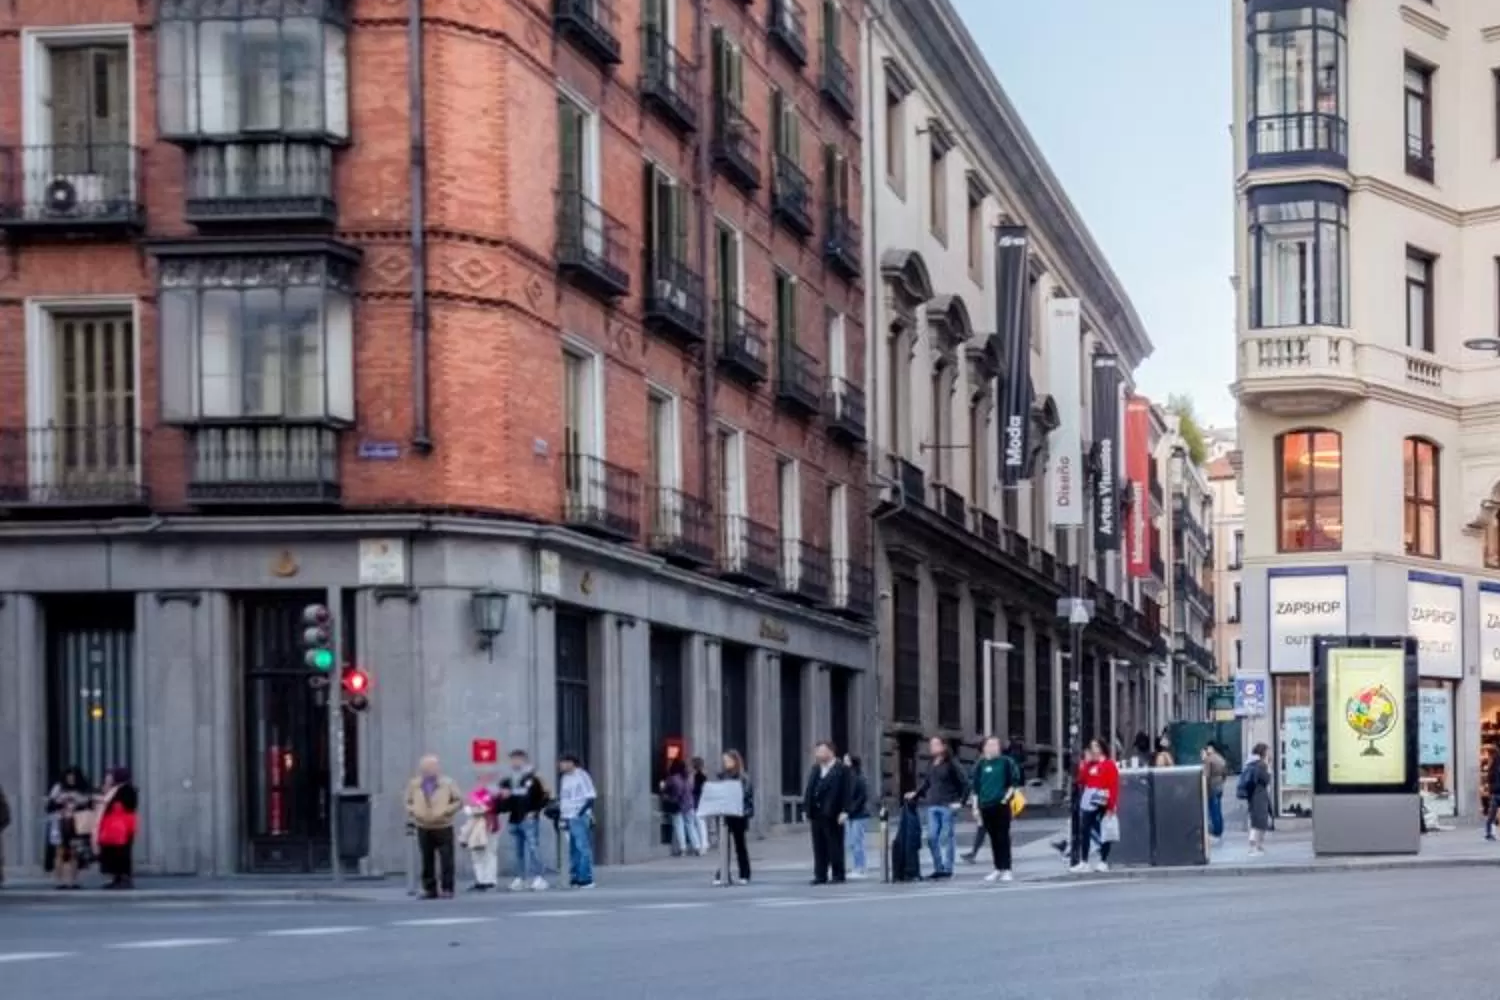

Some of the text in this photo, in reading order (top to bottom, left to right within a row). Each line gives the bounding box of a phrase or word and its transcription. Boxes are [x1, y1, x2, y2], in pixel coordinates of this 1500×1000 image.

[1005, 414, 1023, 467] Moda
[1057, 456, 1071, 507] Diseño
[1098, 497, 1113, 536] Artes
[1275, 600, 1342, 615] ZAPSHOP
[1411, 607, 1457, 625] ZAPSHOP
